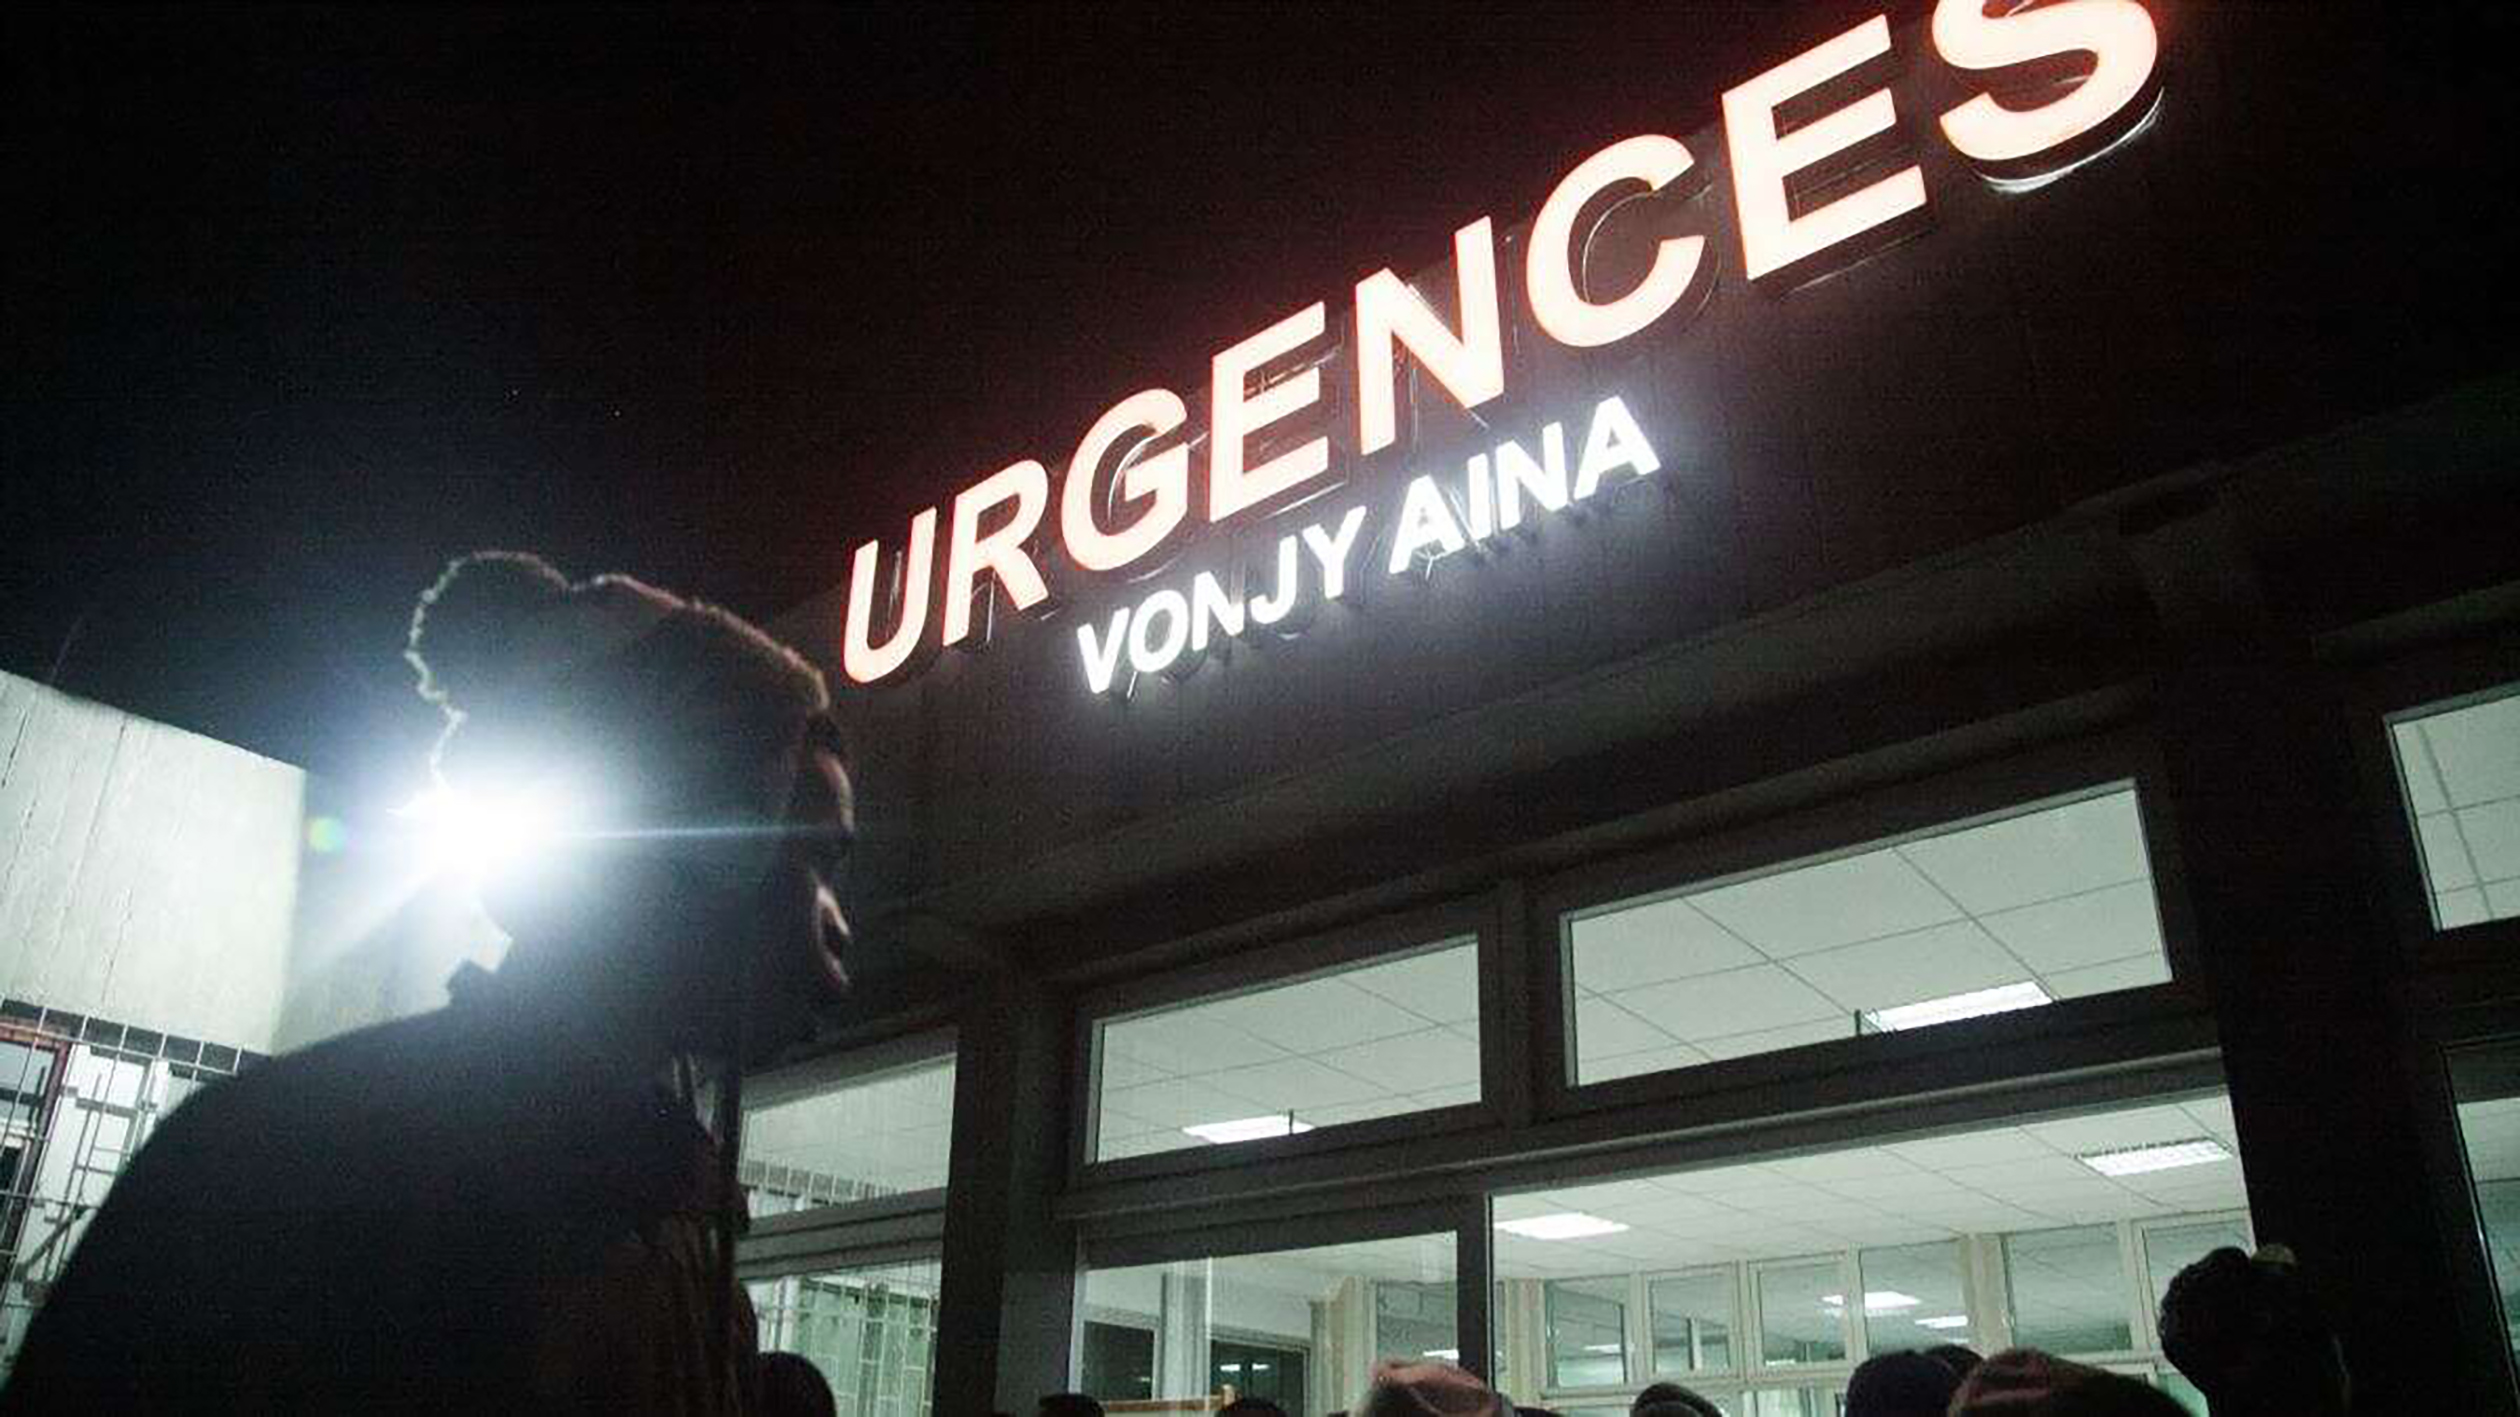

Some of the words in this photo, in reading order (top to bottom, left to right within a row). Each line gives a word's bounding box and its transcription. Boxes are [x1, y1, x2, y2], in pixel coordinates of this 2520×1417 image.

[843, 0, 2158, 683] URGENCES
[1077, 507, 1367, 693] VONJY
[1389, 396, 1661, 573] AINA
